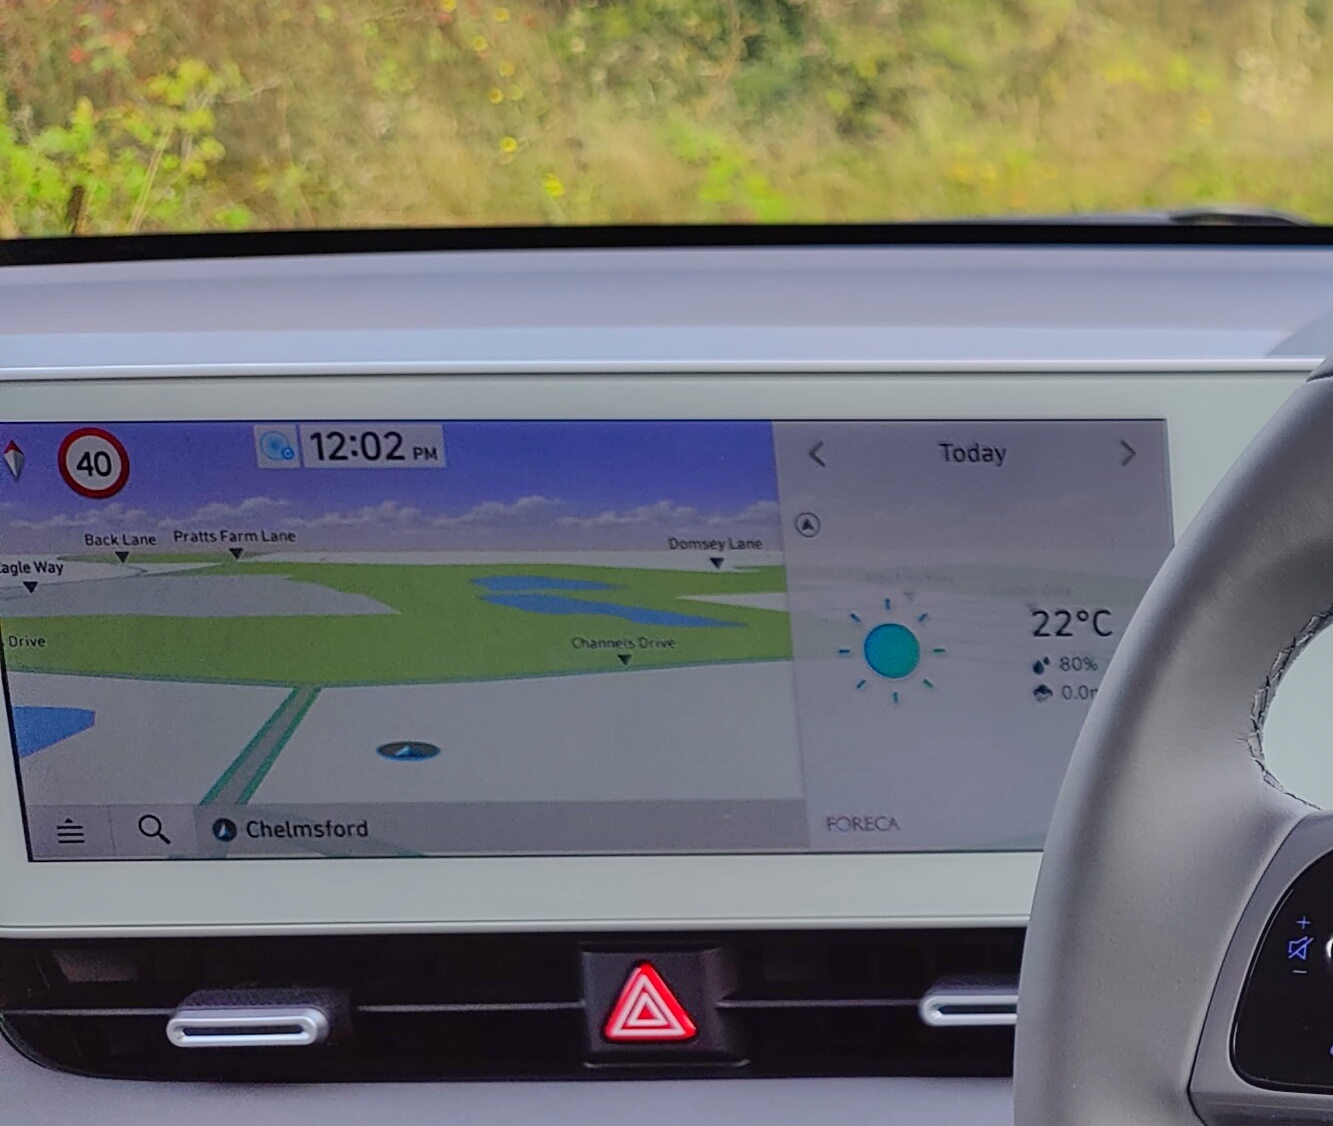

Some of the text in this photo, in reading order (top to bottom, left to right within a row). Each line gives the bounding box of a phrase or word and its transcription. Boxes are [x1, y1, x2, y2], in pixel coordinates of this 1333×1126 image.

[310, 430, 438, 462] 12:02 PM
[938, 442, 1007, 467] Today
[75, 451, 113, 479] 40
[84, 533, 157, 547] Back Lane
[173, 529, 297, 543] Pratts Farm Lane
[667, 537, 763, 552] Domsey Lane
[33, 560, 64, 577] Way
[1031, 609, 1114, 638] 22°C
[8, 635, 47, 649] Drive
[572, 636, 676, 650] Channels Drive
[1059, 655, 1099, 673] 80%
[245, 820, 369, 841] Chelmsford
[825, 815, 901, 833] FORECA
